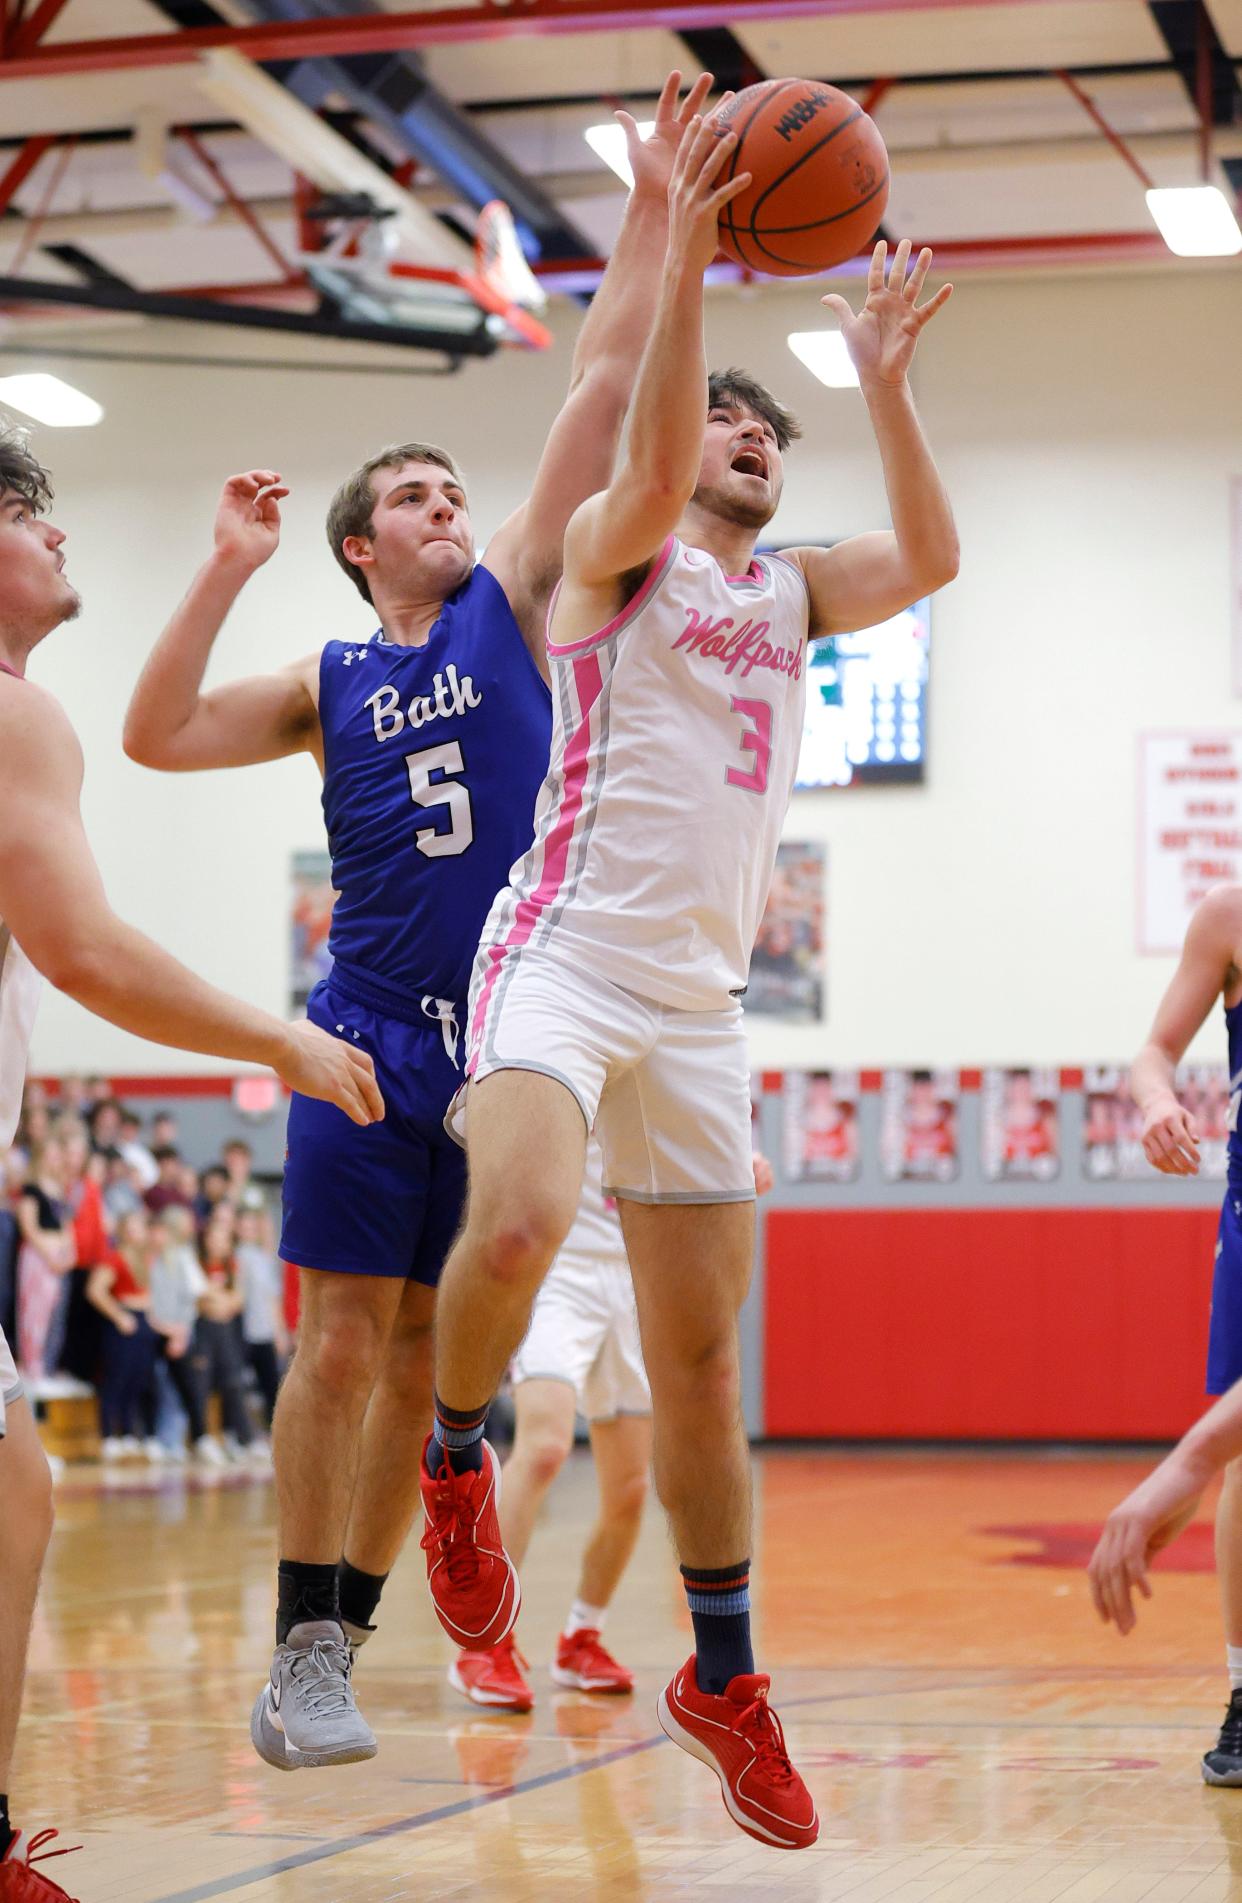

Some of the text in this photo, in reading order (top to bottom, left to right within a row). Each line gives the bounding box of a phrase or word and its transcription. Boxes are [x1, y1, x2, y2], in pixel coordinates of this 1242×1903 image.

[671, 607, 803, 681] Wolfpack
[363, 663, 483, 743] Bath
[724, 693, 774, 795] 3
[404, 739, 475, 859] 5
